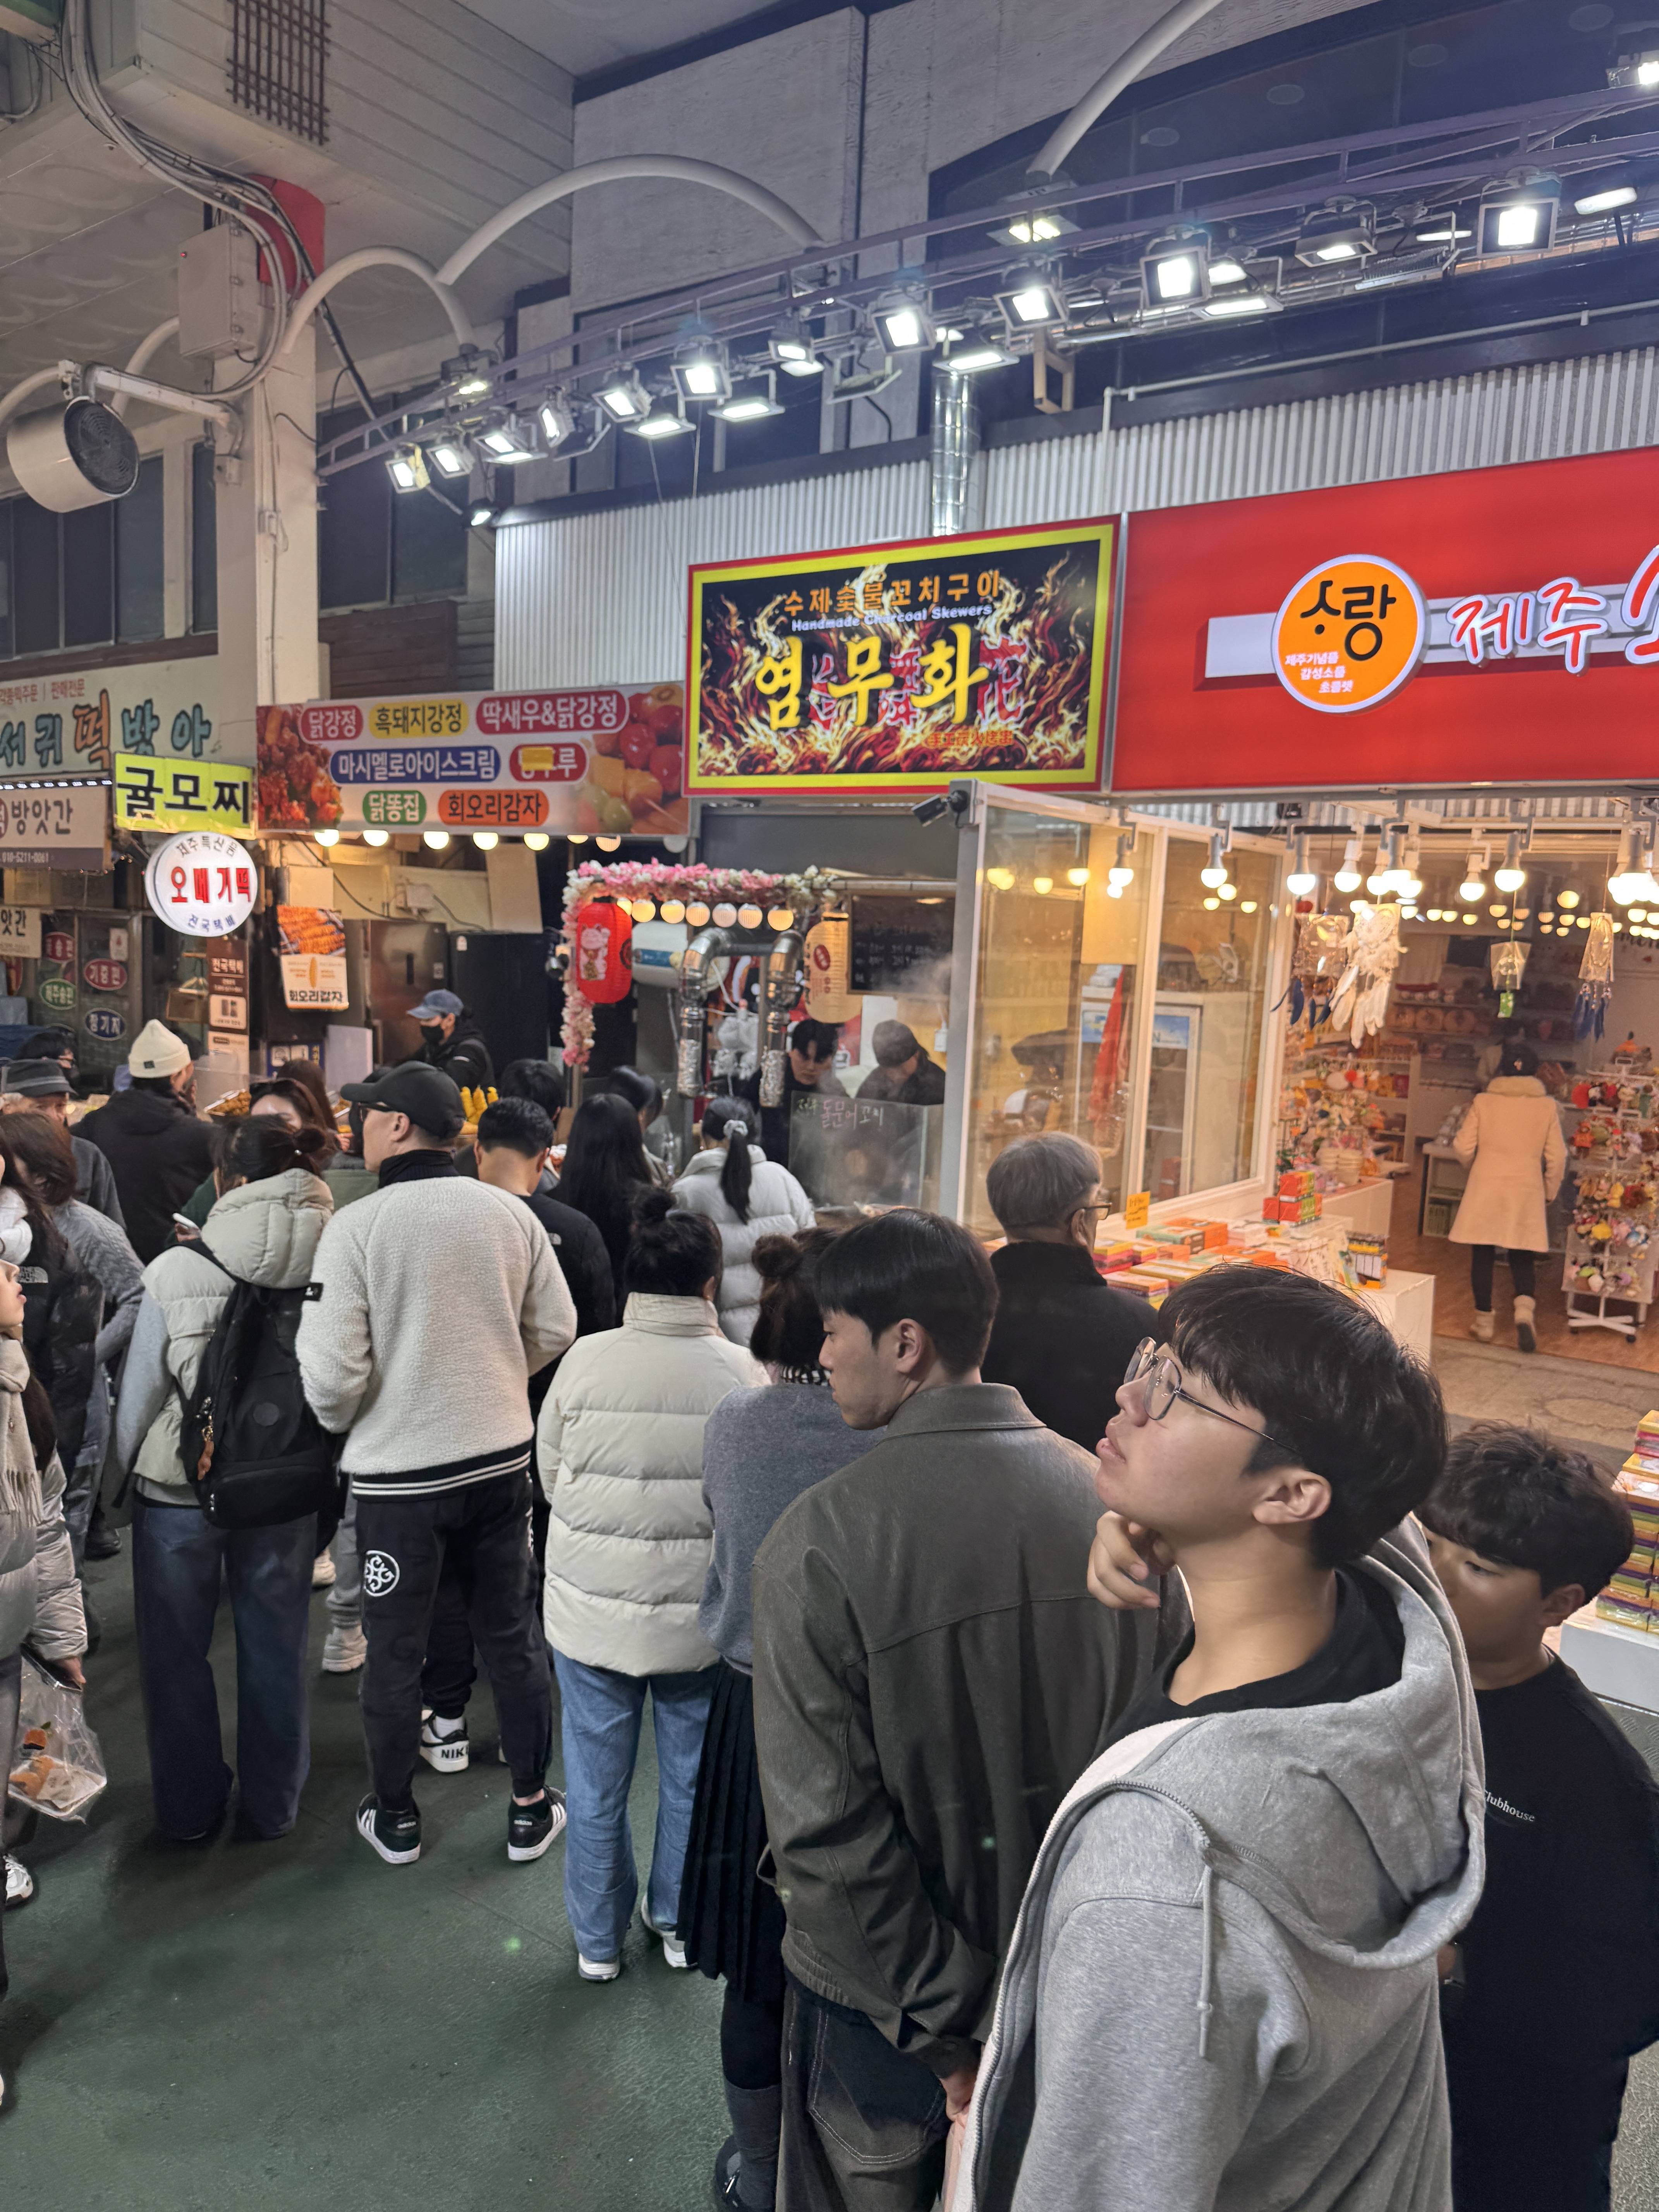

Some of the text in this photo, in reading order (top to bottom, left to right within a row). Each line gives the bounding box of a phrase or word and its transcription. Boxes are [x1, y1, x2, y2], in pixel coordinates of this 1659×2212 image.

[784, 569, 1000, 617] 수제숯불꼬치구이
[792, 604, 993, 632] Handmade Charcoal Skewers
[1448, 577, 1607, 674] 제주
[755, 623, 989, 731] 염무화
[310, 695, 618, 739] 닭강정 흑돼지강정 딱새우&닭강정
[338, 749, 495, 781] 마시멜로아이스크림
[118, 766, 249, 824] 귤모찌
[369, 792, 541, 823] 닭똥집 회오리감자
[12, 798, 74, 835] 방앗간
[289, 989, 343, 1004] 회오리감자
